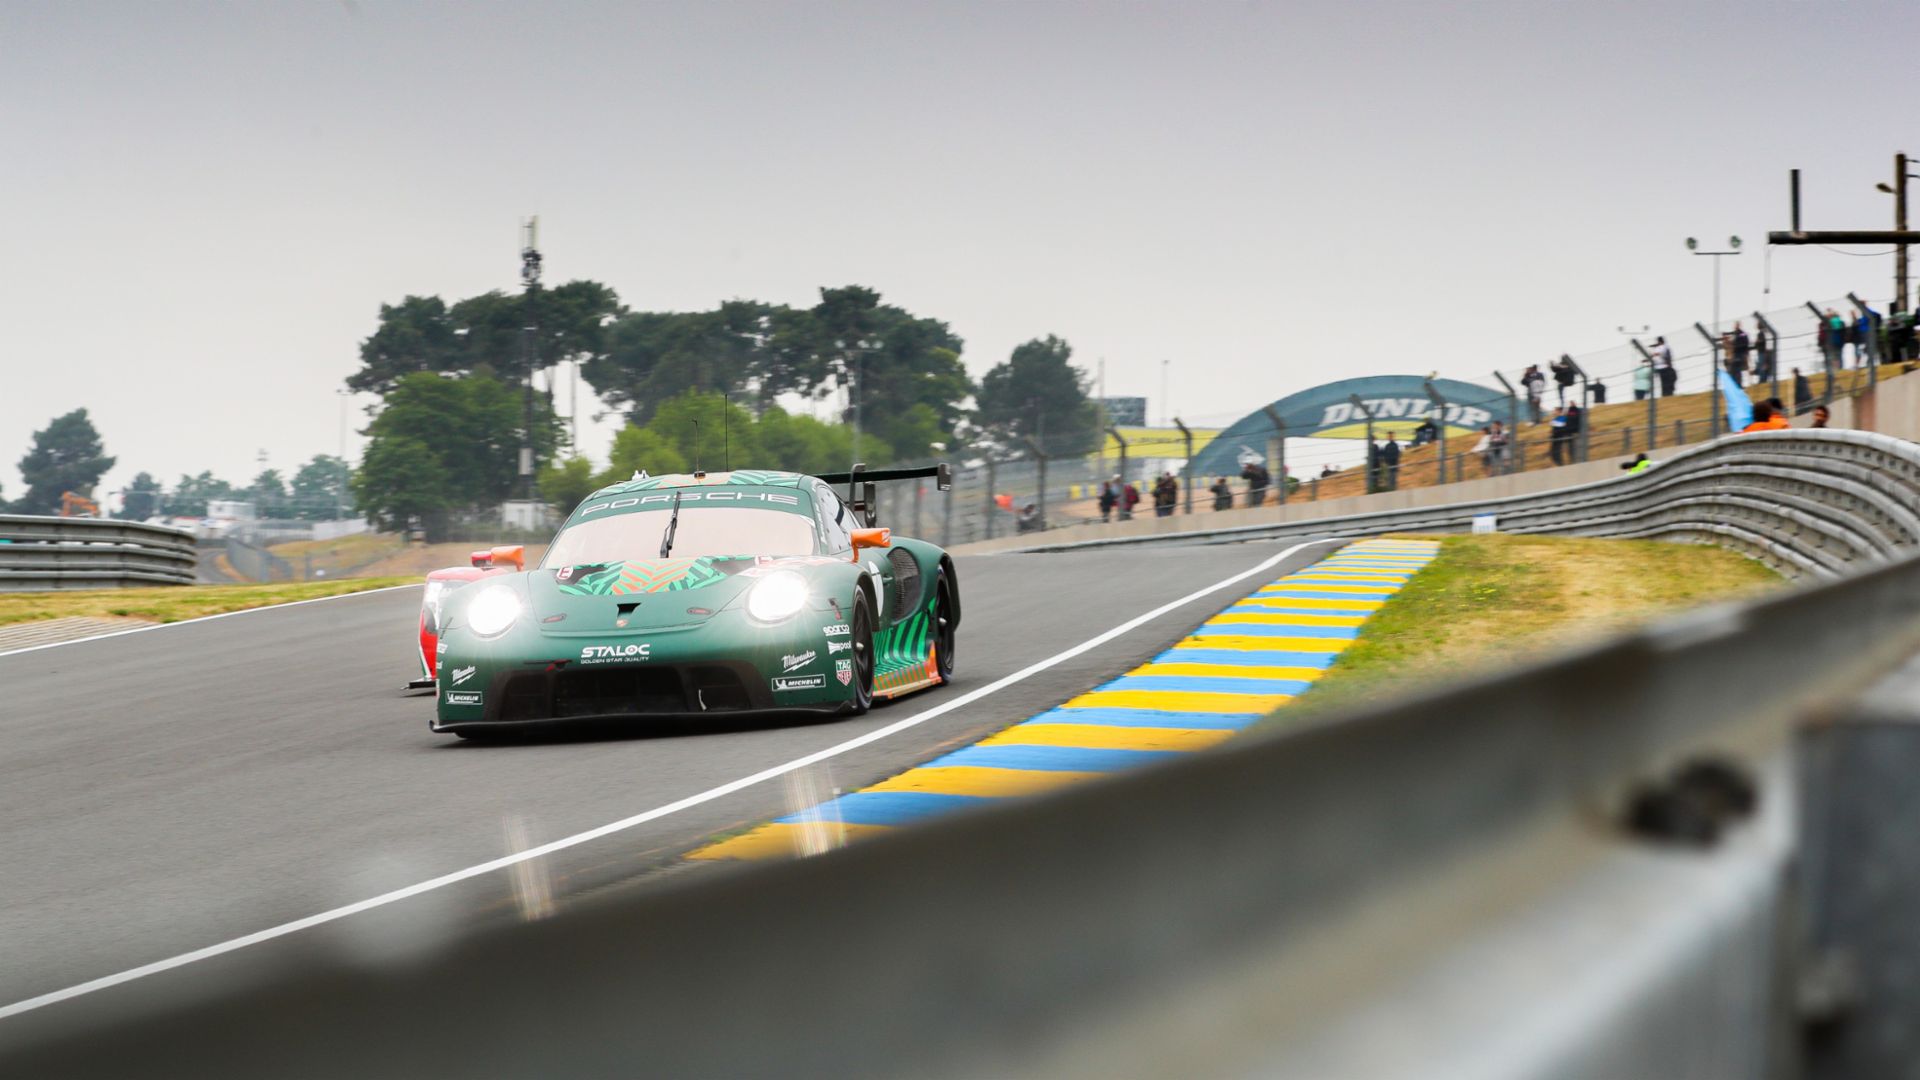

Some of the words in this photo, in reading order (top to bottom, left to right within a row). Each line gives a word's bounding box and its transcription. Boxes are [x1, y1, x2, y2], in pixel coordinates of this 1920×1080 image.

[1318, 399, 1492, 426] DUNLOP
[580, 492, 799, 516] PORSCHE
[581, 644, 651, 658] STALOC
[837, 661, 851, 670] TAG
[788, 678, 822, 686] MICHELIN
